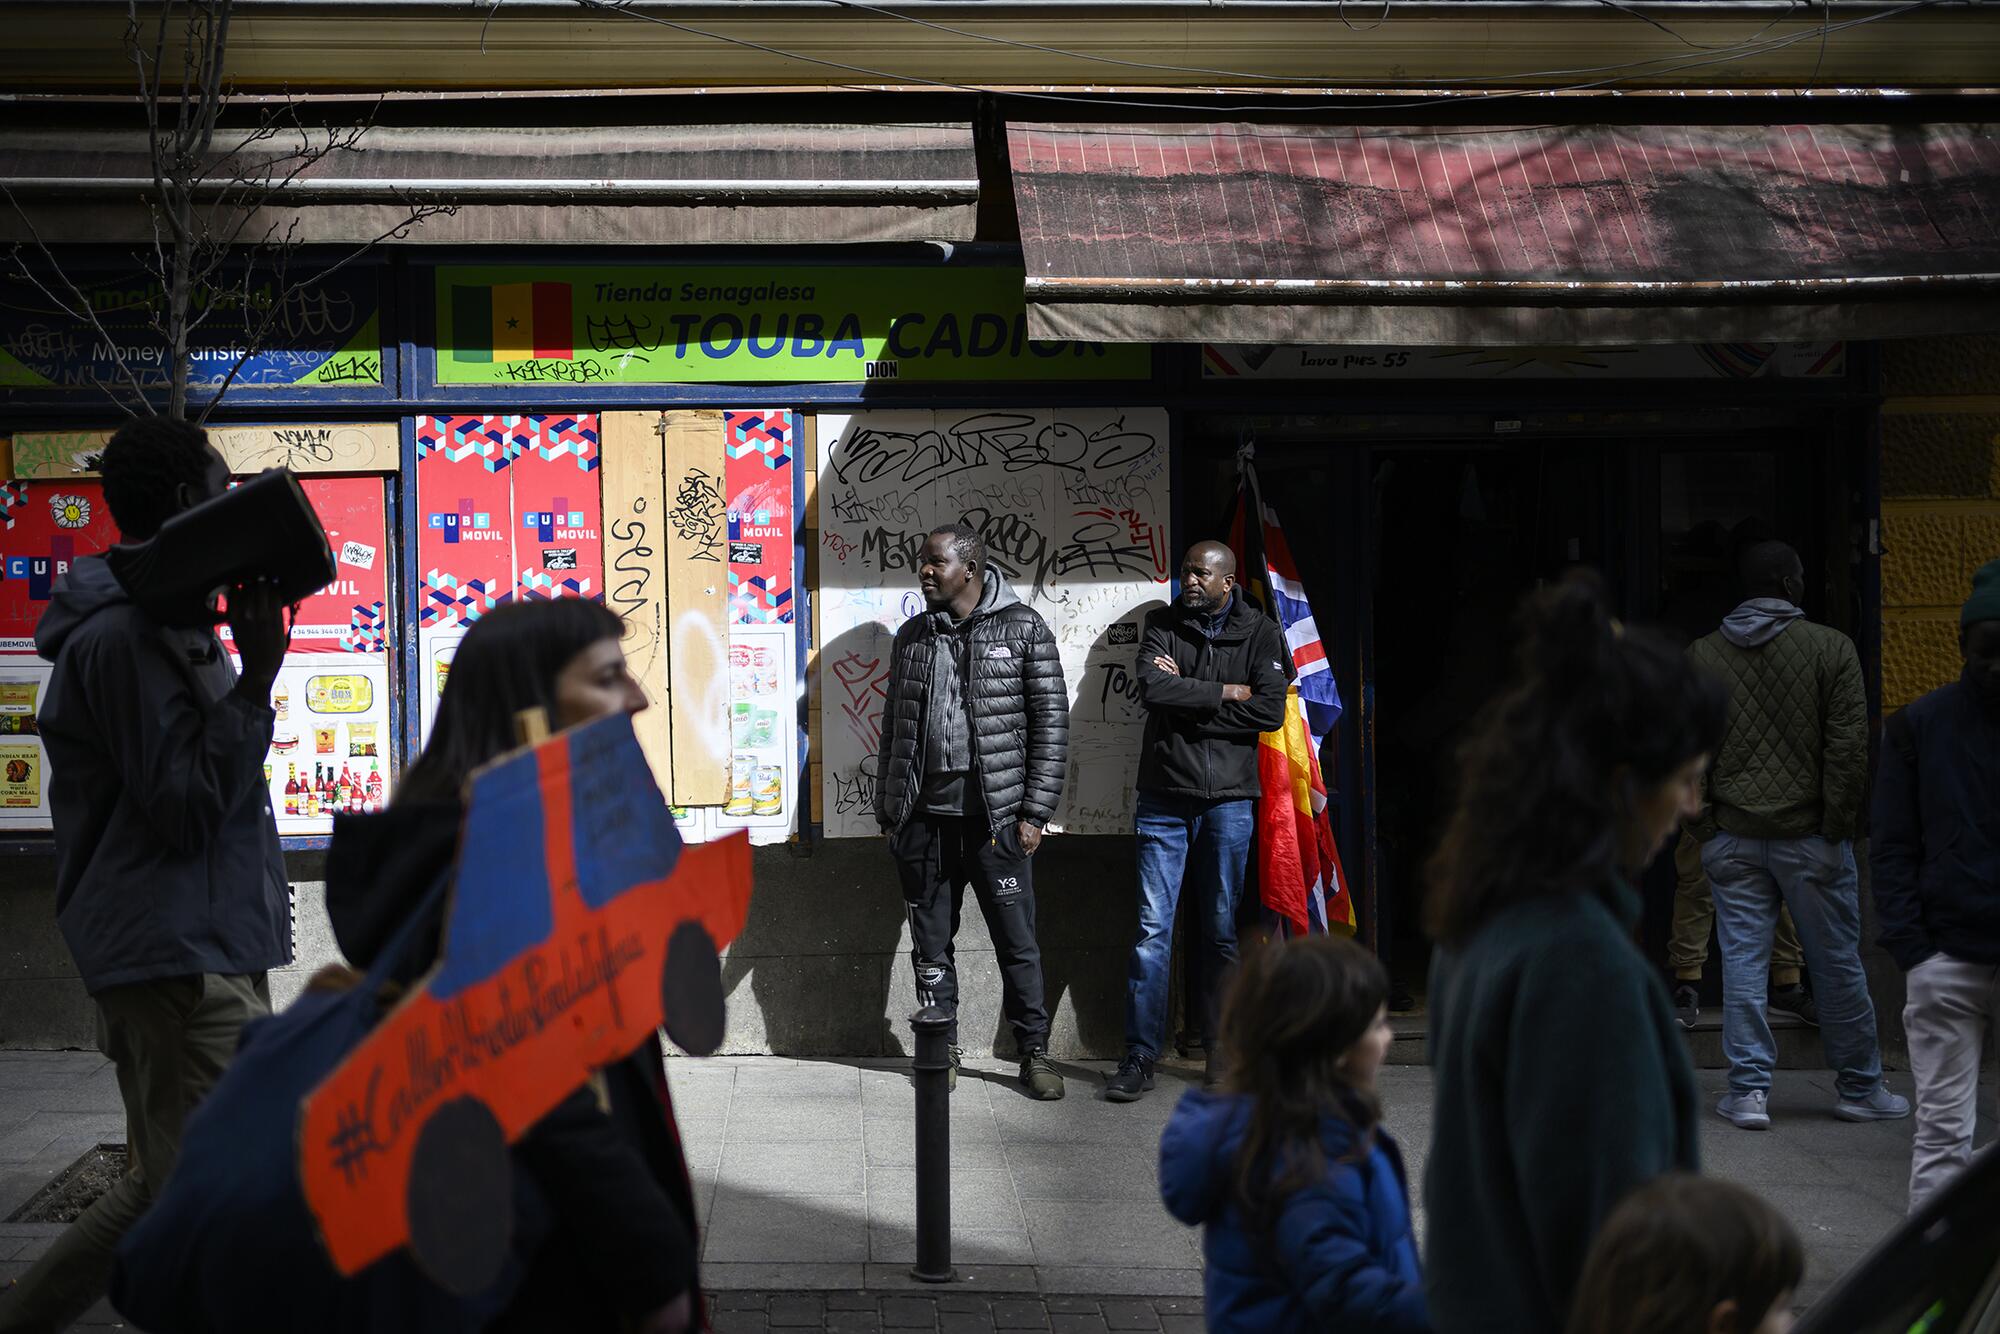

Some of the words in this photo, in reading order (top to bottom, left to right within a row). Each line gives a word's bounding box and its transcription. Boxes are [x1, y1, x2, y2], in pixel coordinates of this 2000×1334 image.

[594, 281, 672, 301] Tienda
[680, 281, 815, 305] Senagalesa
[671, 313, 866, 359] TOUBA
[92, 341, 166, 366] Money
[865, 361, 898, 378] DION
[432, 515, 486, 526] CUBE
[526, 515, 579, 525] CUBE
[462, 531, 503, 541] MOVIL
[556, 530, 597, 540] MOVIL
[743, 527, 784, 538] MOVIL
[315, 580, 360, 595] VIL
[1099, 663, 1139, 705] TOU
